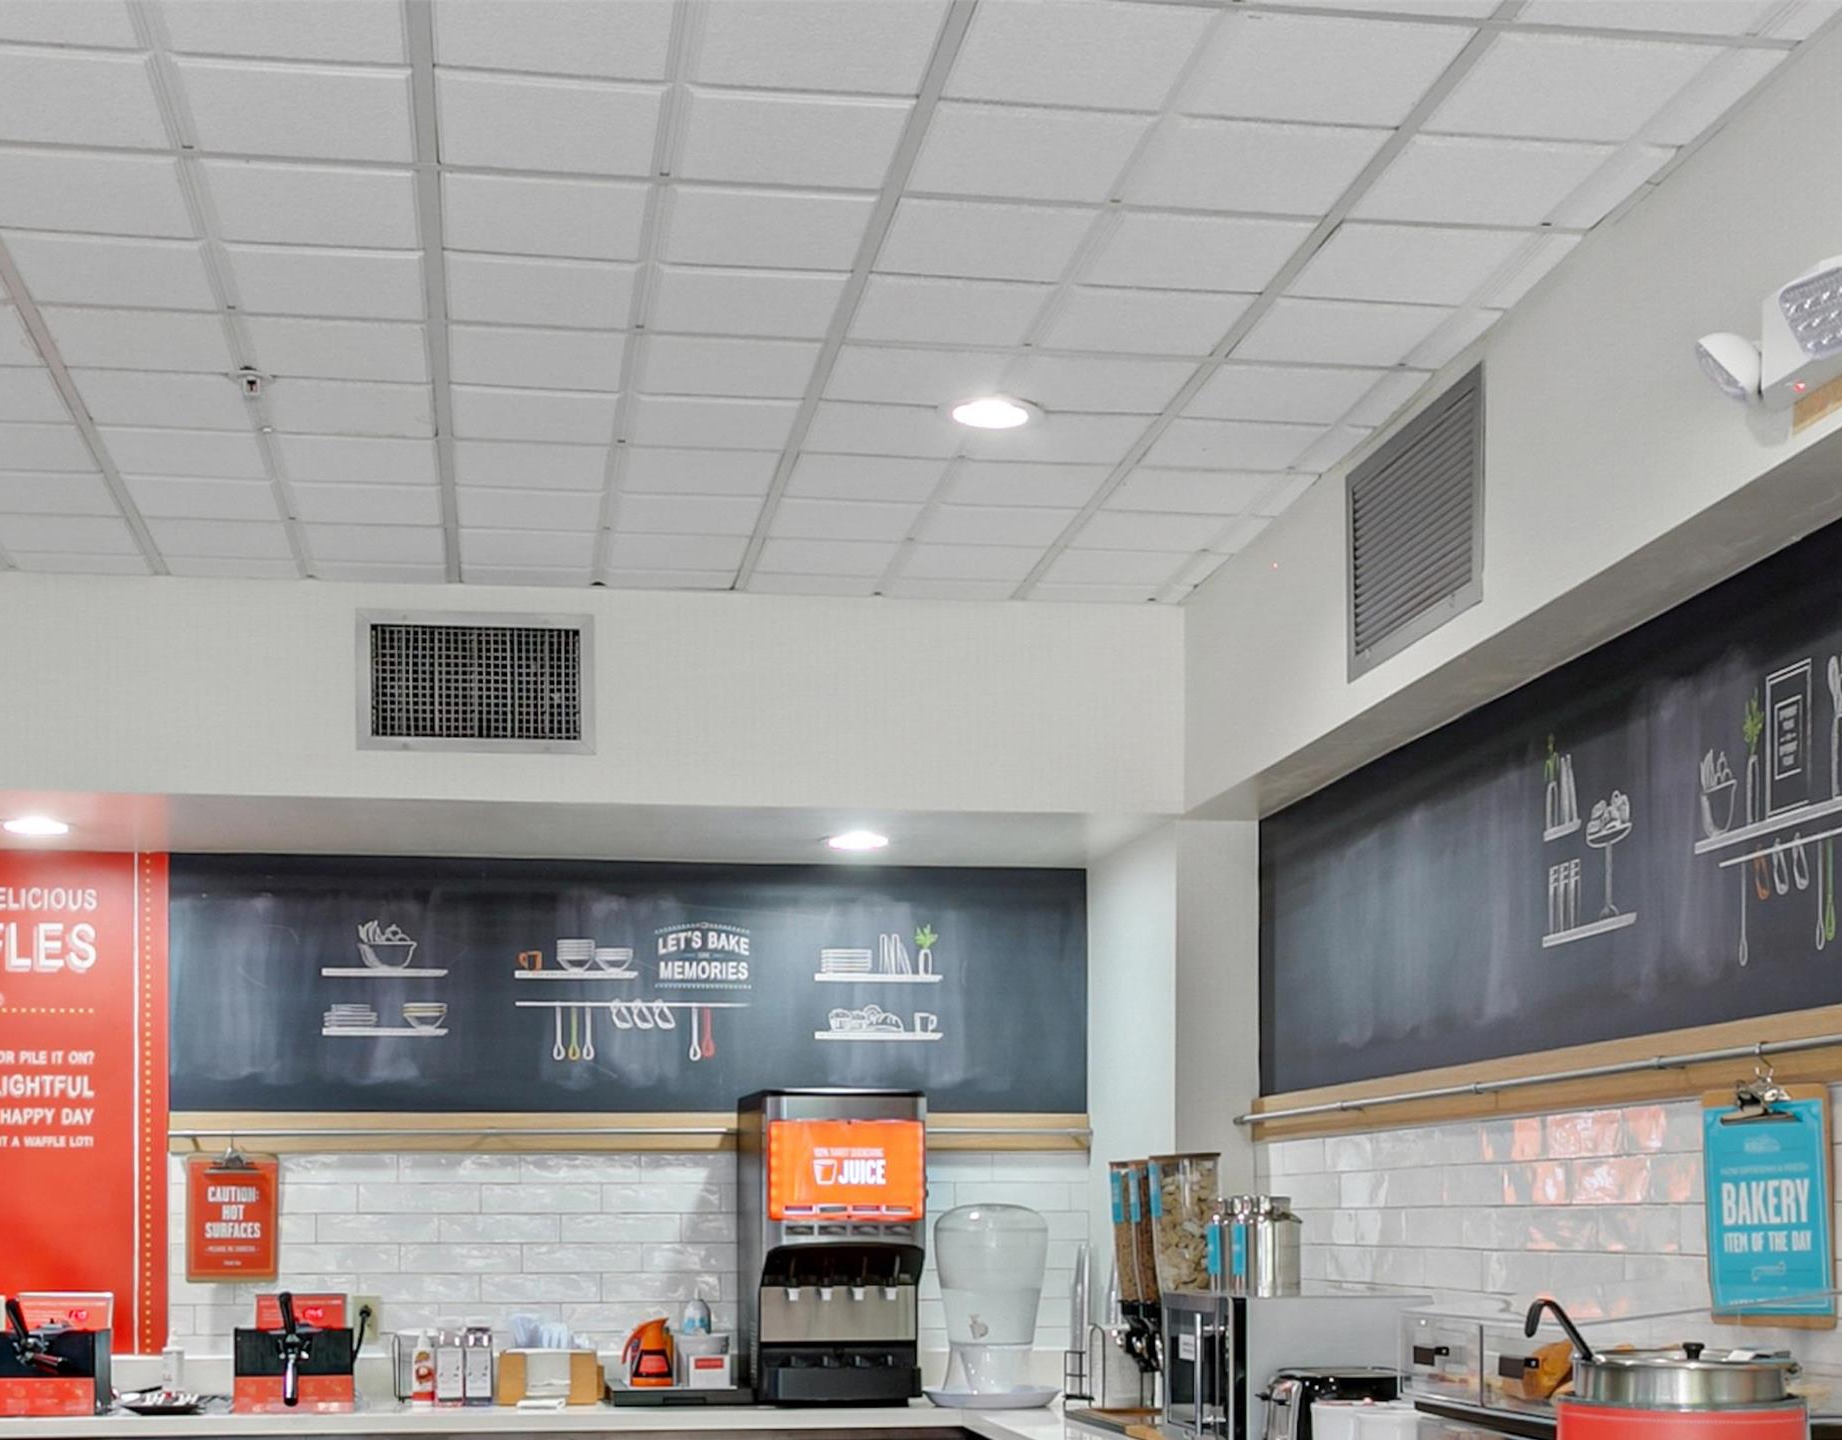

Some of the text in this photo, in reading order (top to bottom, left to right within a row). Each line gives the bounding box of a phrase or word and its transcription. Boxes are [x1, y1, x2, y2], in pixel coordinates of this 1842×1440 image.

[658, 930, 750, 956] LET'S BAKE
[659, 961, 749, 980] MEMORIES
[19, 1051, 47, 1064] PILE
[51, 1051, 63, 1065] IT
[68, 1051, 95, 1065] ON?
[0, 1108, 55, 1125] HAPPY
[61, 1108, 95, 1125] DAY
[11, 1136, 20, 1147] A
[24, 1136, 66, 1147] WAFFLE
[69, 1136, 95, 1147] LOT!
[838, 1159, 887, 1184] JUICE
[208, 1186, 260, 1202] CAUTION:
[1721, 1178, 1810, 1226] BAKERY
[222, 1204, 244, 1220] HOT
[205, 1222, 261, 1238] SURFACES
[1724, 1230, 1811, 1253] ITEM OF THE DAY
